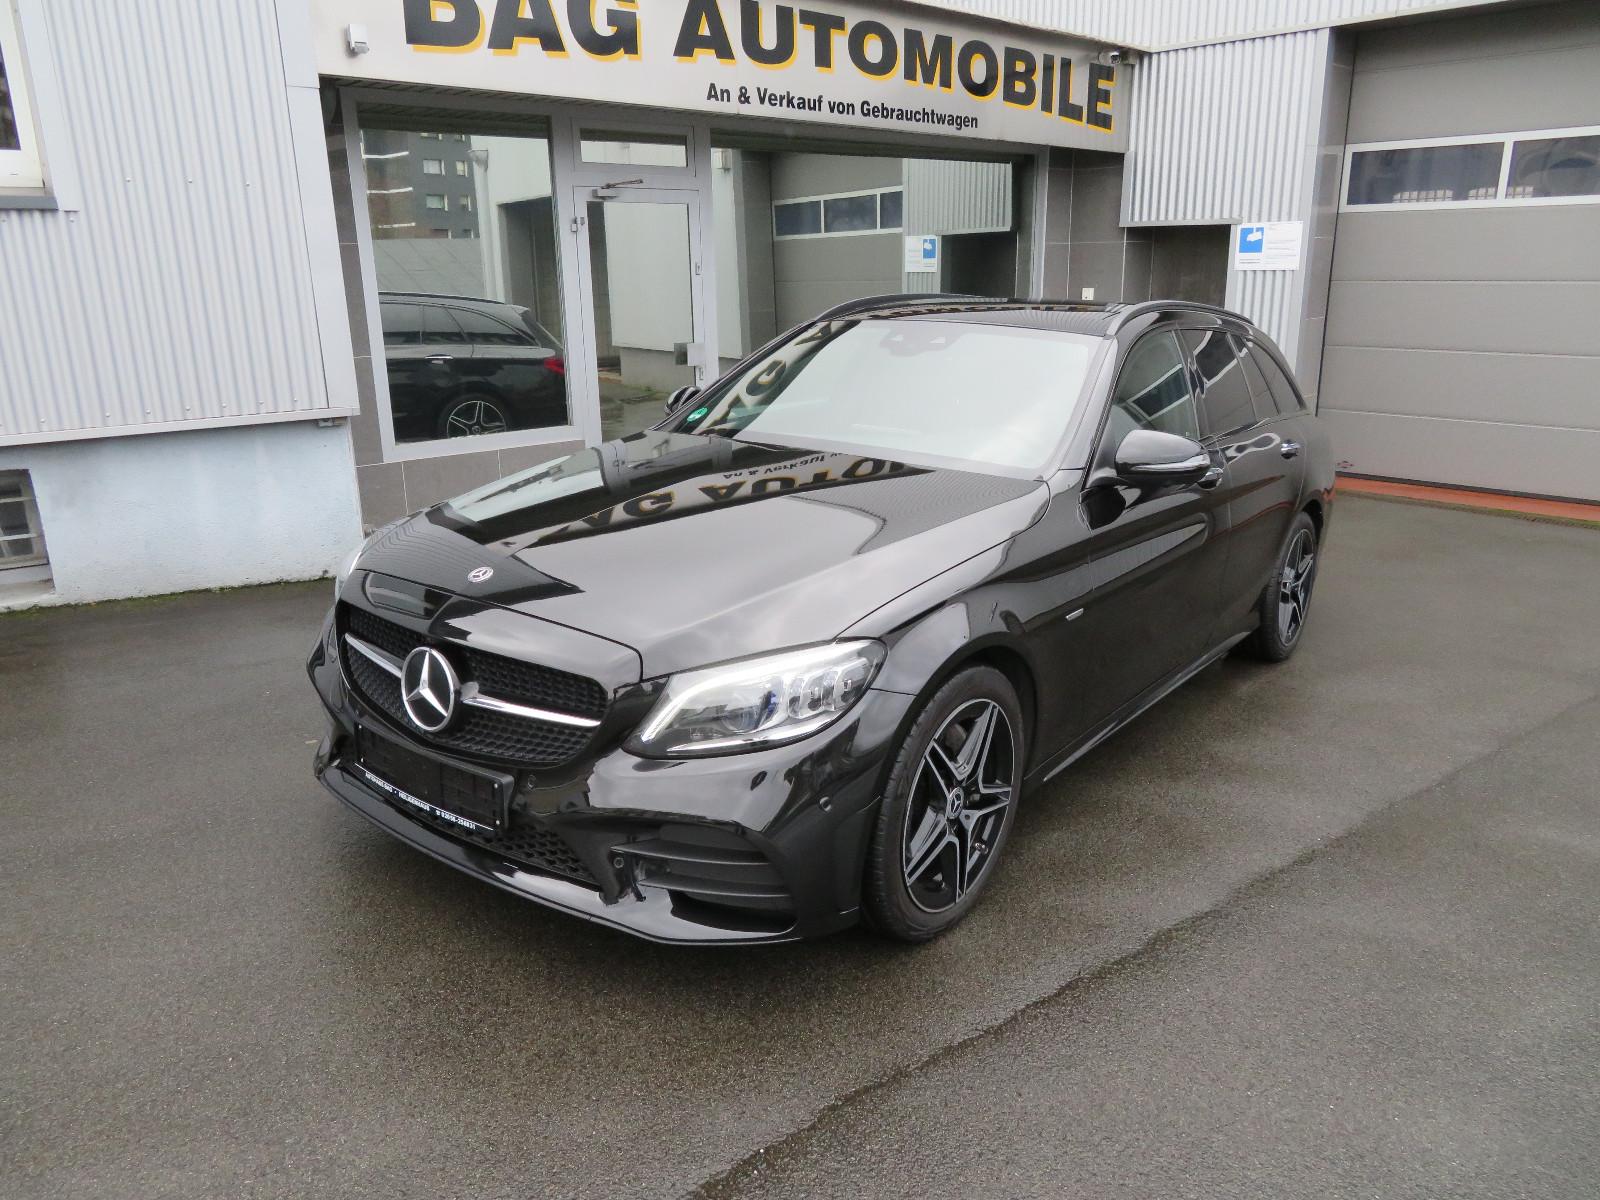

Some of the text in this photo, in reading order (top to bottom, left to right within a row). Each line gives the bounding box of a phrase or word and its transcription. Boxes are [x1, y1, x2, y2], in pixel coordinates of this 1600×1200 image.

[403, 0, 1115, 133] BAG AUTOMOBILE
[706, 82, 978, 130] An & Verkauf von Gebrauchtwagen
